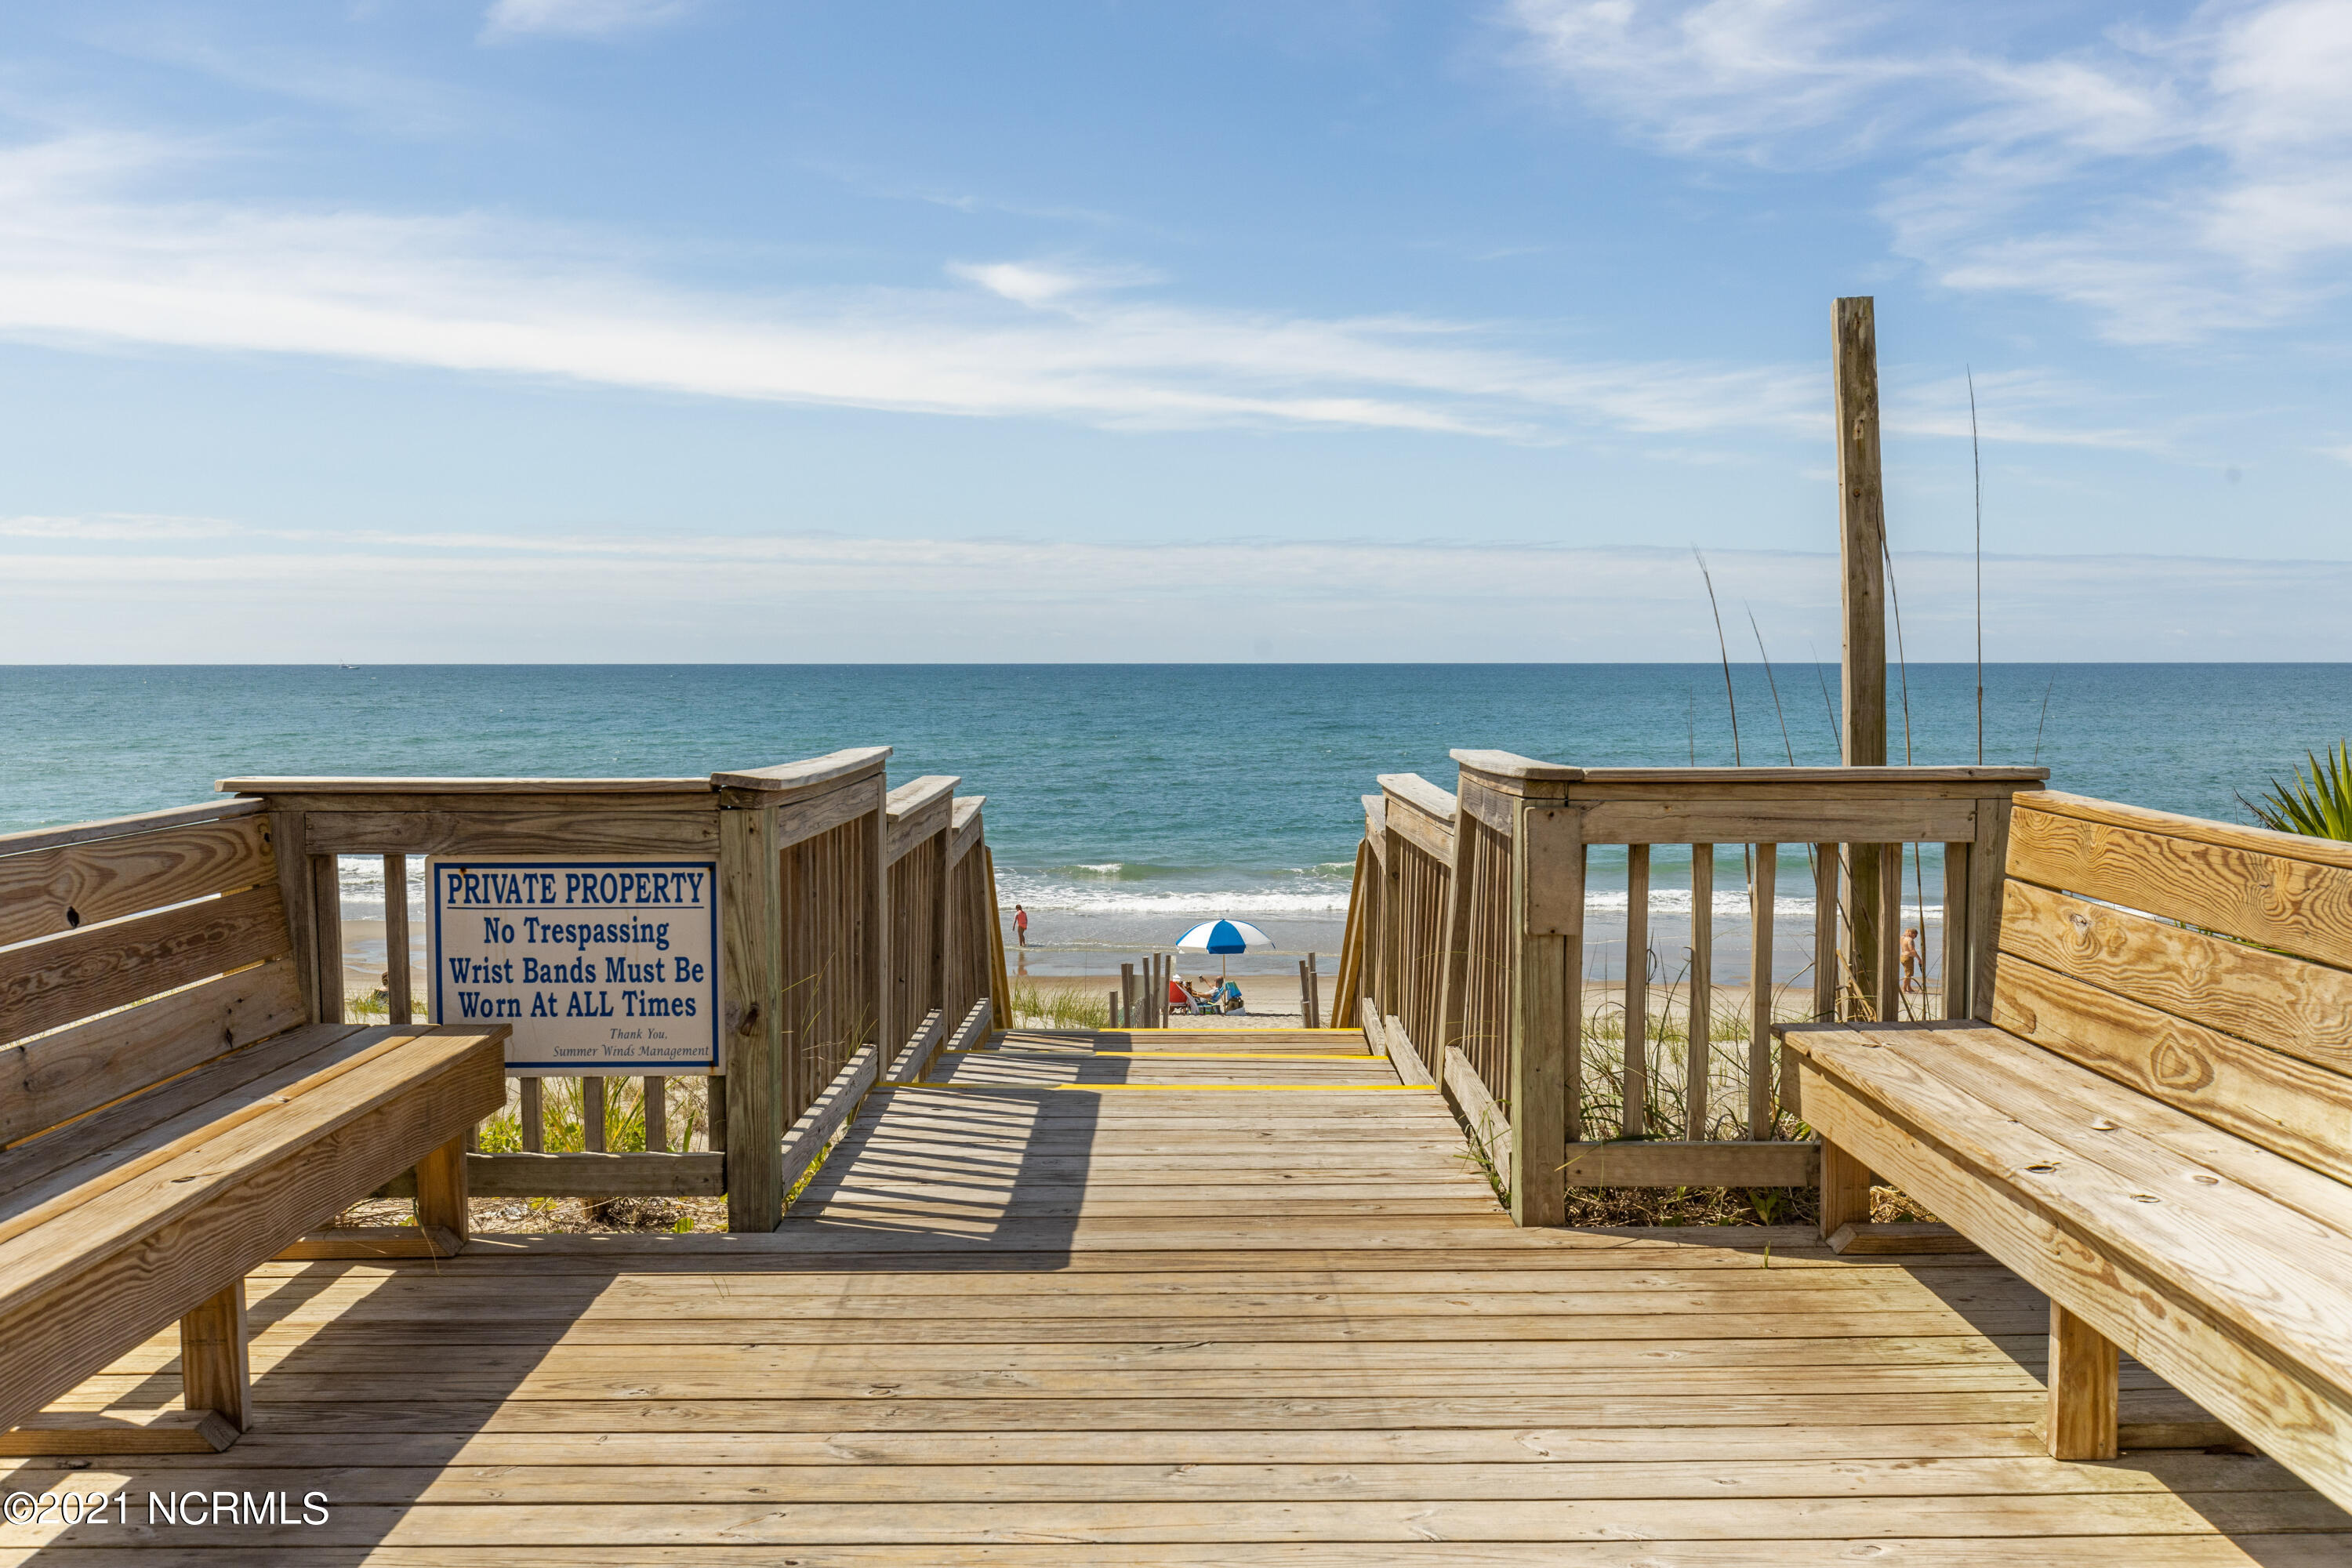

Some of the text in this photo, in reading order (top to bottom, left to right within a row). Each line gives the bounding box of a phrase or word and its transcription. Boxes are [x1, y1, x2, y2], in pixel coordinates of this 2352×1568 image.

[448, 873, 703, 904] PRIVATE PROPERTY
[484, 916, 670, 951] No Trespassing
[449, 956, 704, 983] Wrist Bands Must Be
[458, 990, 696, 1018] Worn At ALL Times
[610, 1029, 641, 1040] Thank
[554, 1044, 709, 1060] Summer Winds Management
